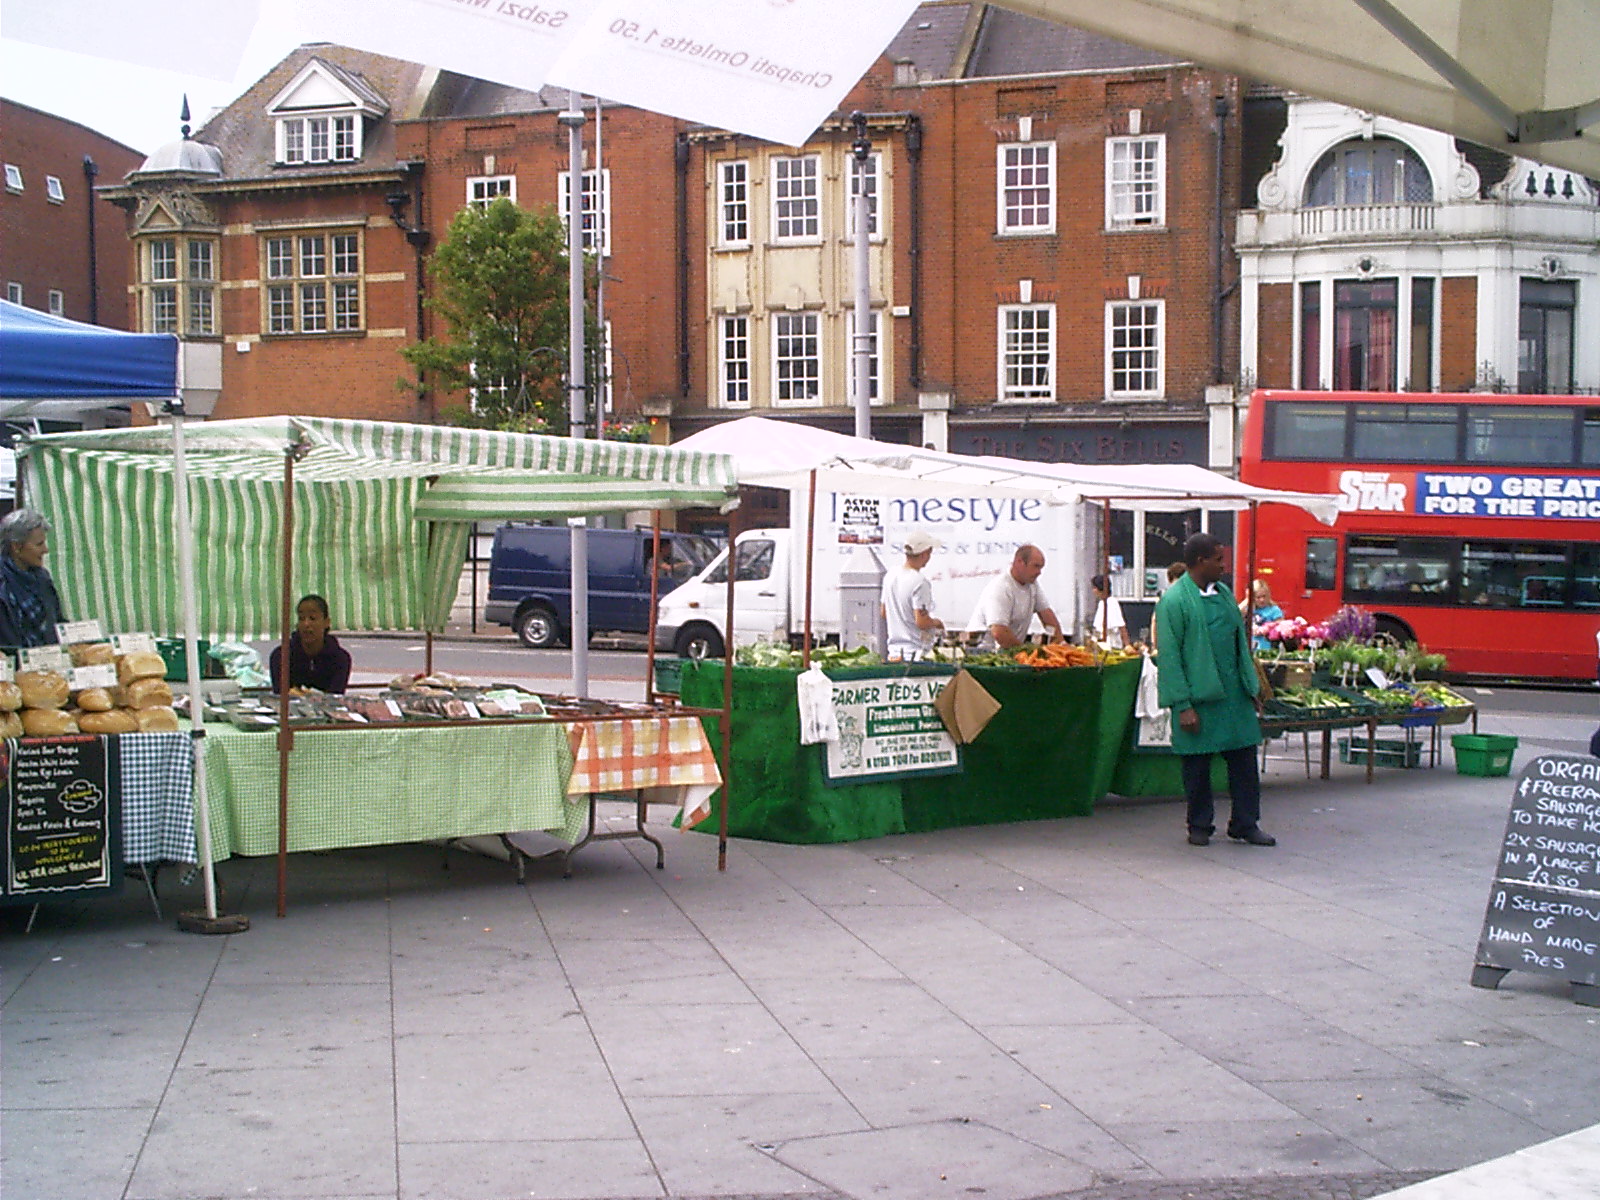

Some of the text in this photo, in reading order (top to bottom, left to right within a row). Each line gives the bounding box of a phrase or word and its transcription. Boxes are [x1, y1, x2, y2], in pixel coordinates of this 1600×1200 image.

[971, 435, 1185, 460] THE SIX BELLS
[1338, 470, 1407, 512] STAR
[1425, 475, 1600, 498] TWO GREAT
[831, 491, 1042, 532] mestyle
[844, 498, 880, 506] ACTON
[1425, 496, 1476, 514] FOR
[1484, 498, 1536, 516] THE
[886, 683, 921, 701] TED'S
[1540, 760, 1600, 781] ORGA
[1513, 809, 1532, 824] TO
[1536, 813, 1578, 829] TAKE
[1505, 852, 1520, 864] IN
[1525, 853, 1537, 866] A
[1543, 856, 1591, 874] LARGE
[1494, 891, 1600, 921] A SELECTION
[1533, 916, 1556, 929] OF
[1489, 926, 1598, 955] HAND MADE
[1521, 948, 1565, 969] PIES
